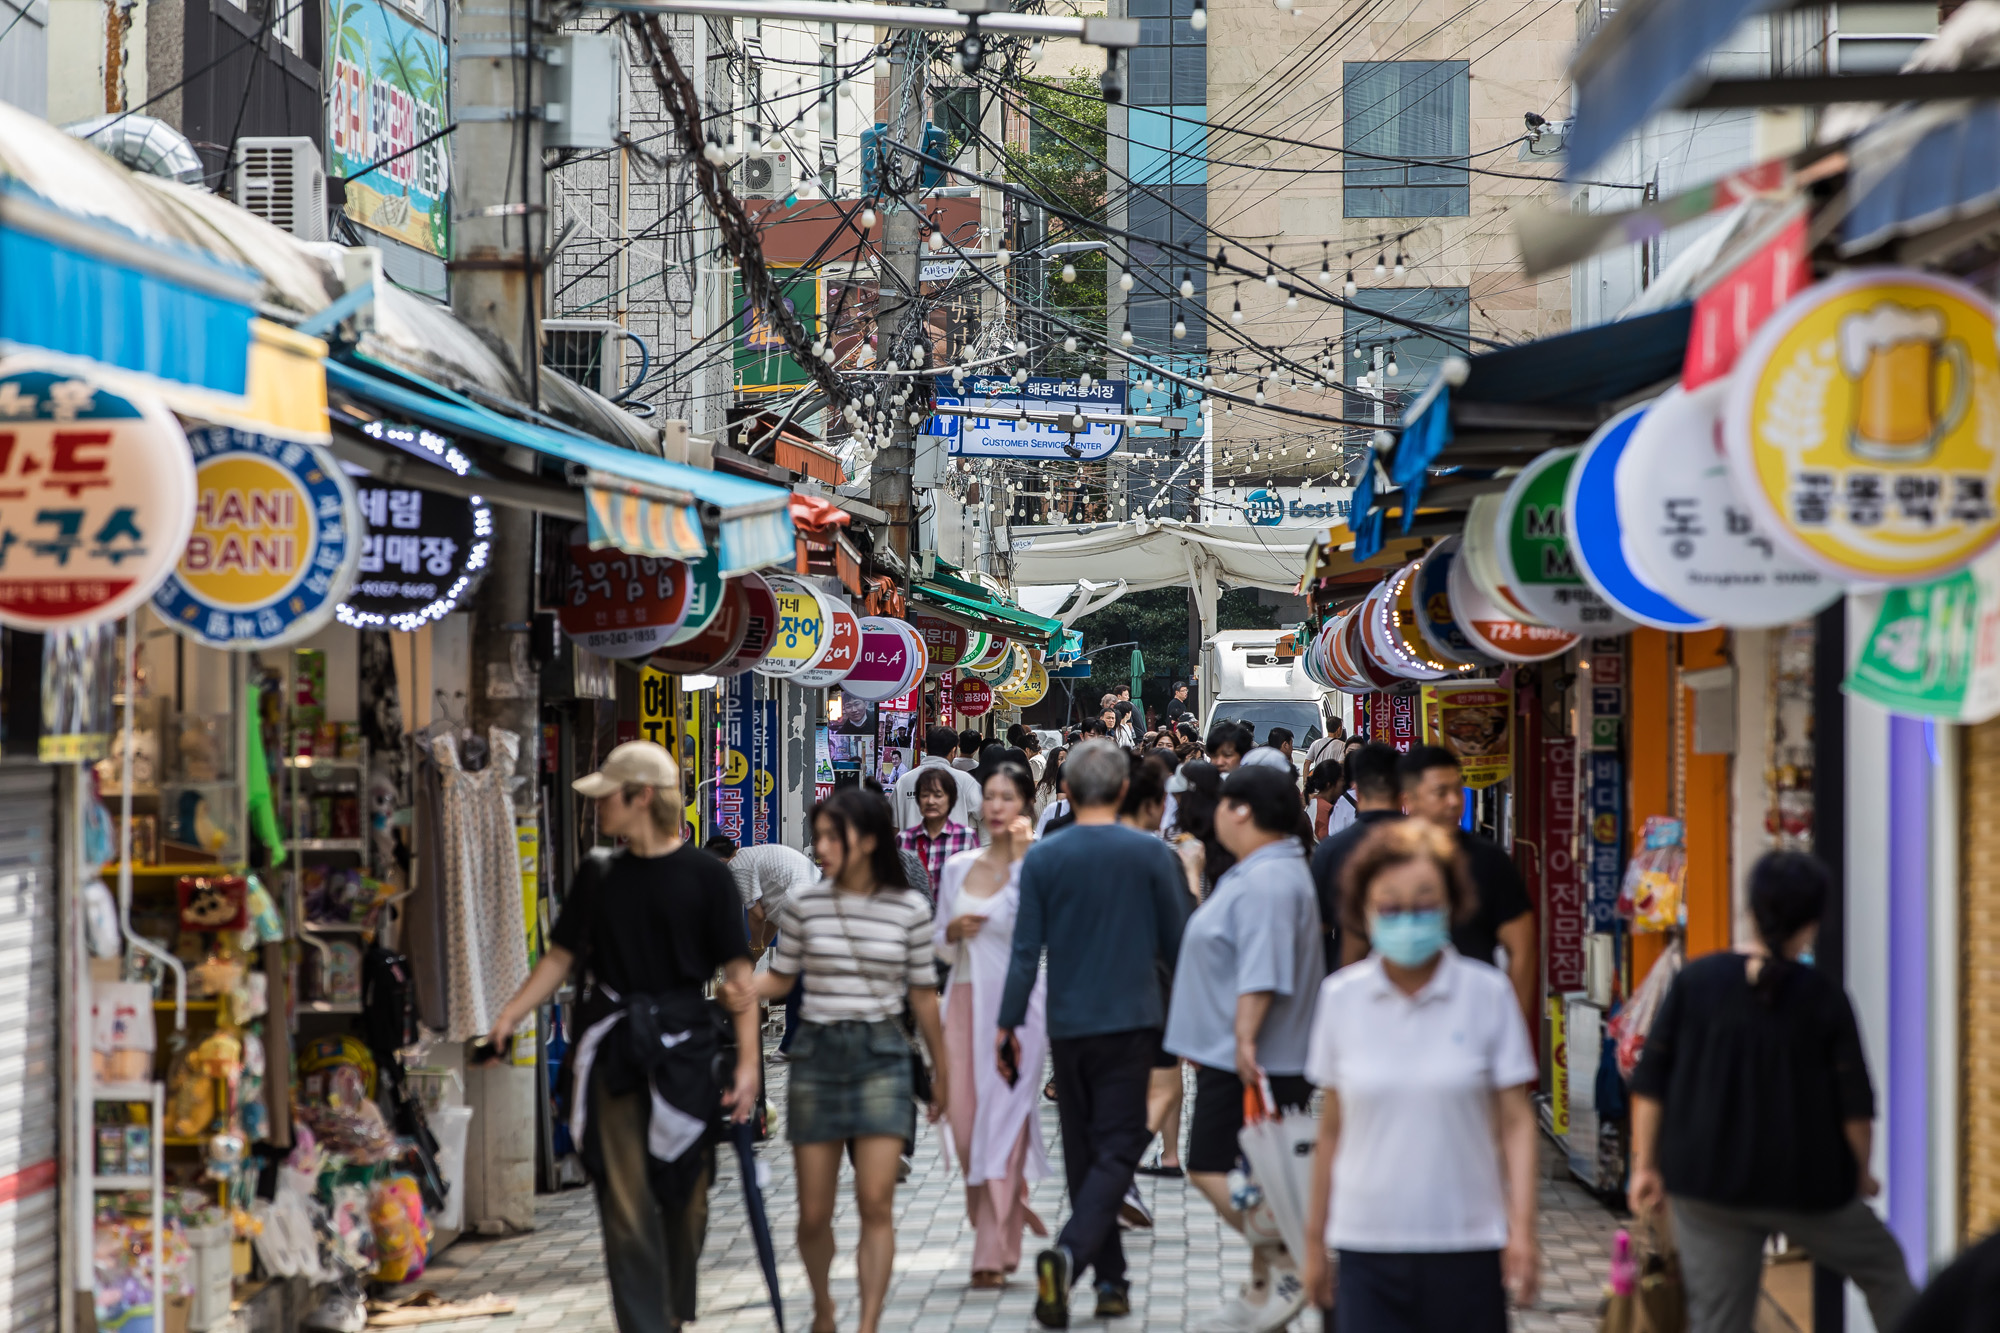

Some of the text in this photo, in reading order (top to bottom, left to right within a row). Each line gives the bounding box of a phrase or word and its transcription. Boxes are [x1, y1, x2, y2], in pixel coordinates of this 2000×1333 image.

[1027, 382, 1115, 399] 해운대전통시장
[982, 437, 1102, 451] CUSTOMER SERVICE CENTER
[1289, 500, 1334, 518] Best
[186, 537, 294, 571] BANI
